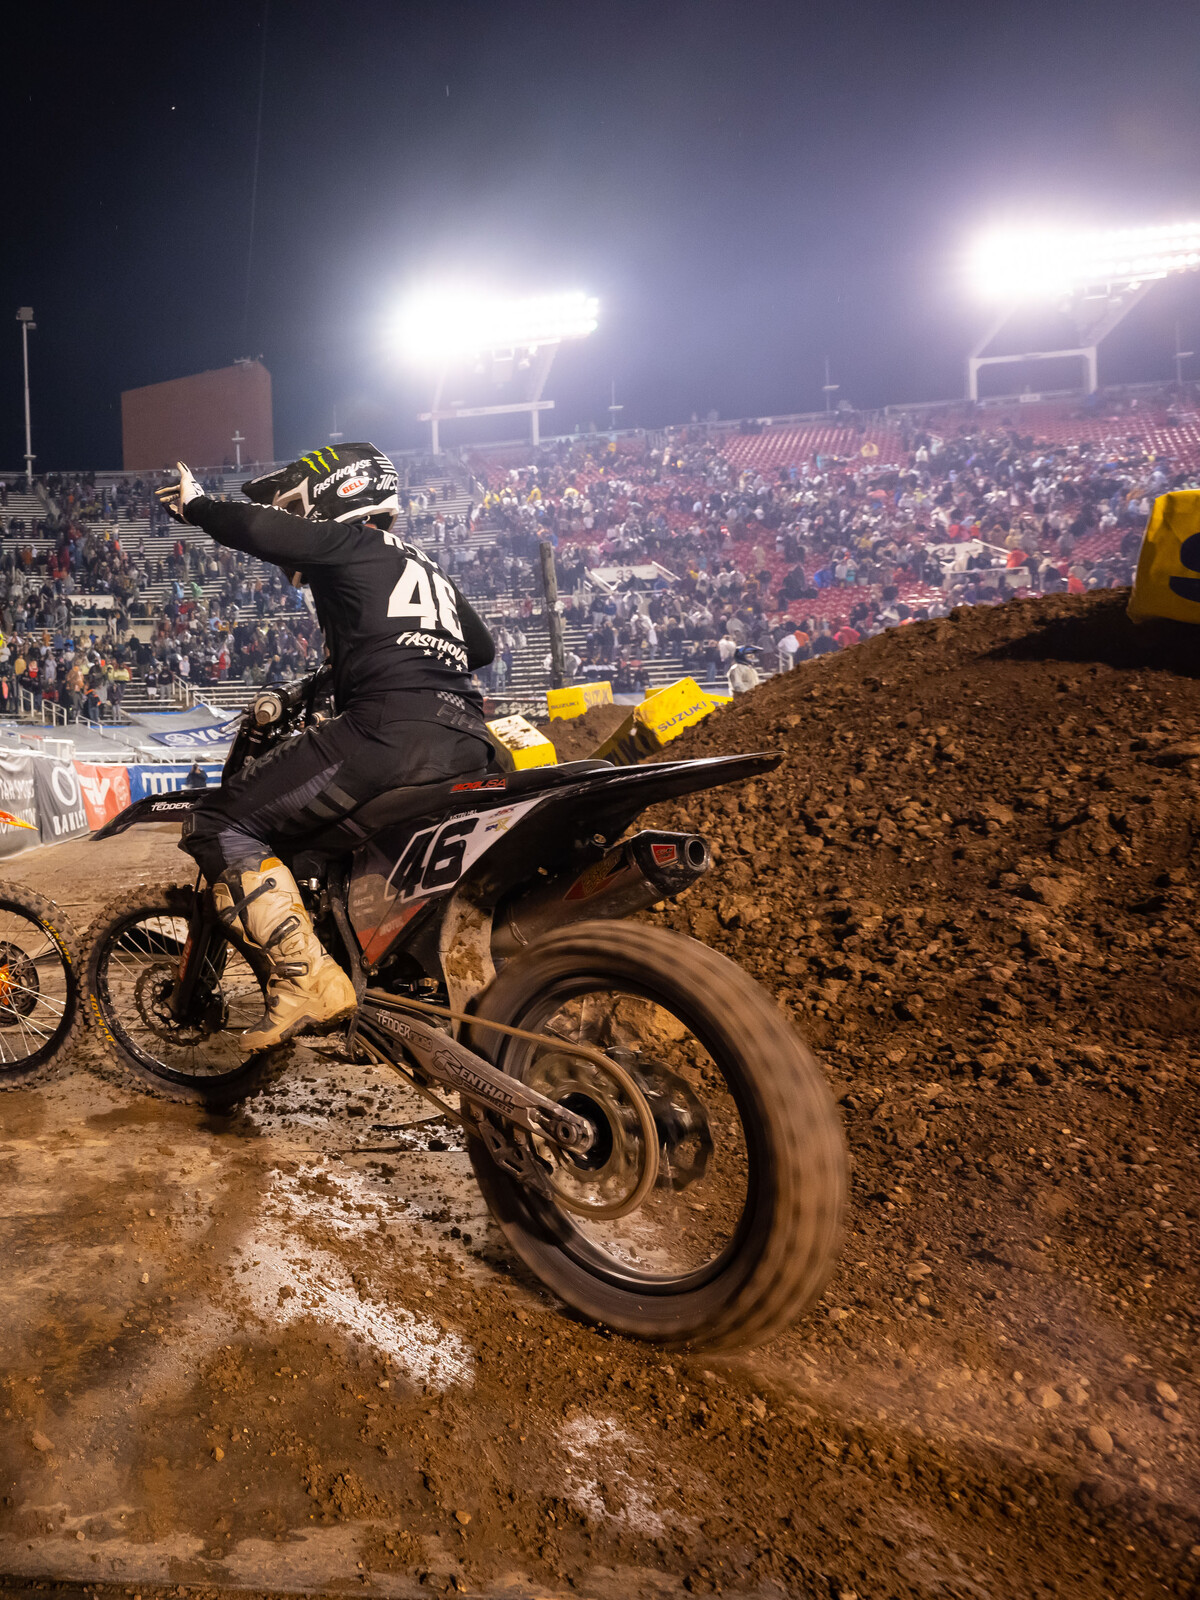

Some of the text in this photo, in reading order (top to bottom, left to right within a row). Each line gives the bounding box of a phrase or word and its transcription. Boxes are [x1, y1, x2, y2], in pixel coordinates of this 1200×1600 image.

[313, 459, 373, 499] FASTHOUSE
[342, 480, 365, 494] BELL
[657, 700, 707, 733] SUZUKI
[52, 809, 88, 836] OAKLEY
[386, 817, 481, 902] 46
[376, 1012, 411, 1039] TEDDER
[433, 1050, 513, 1106] RENTHAL
